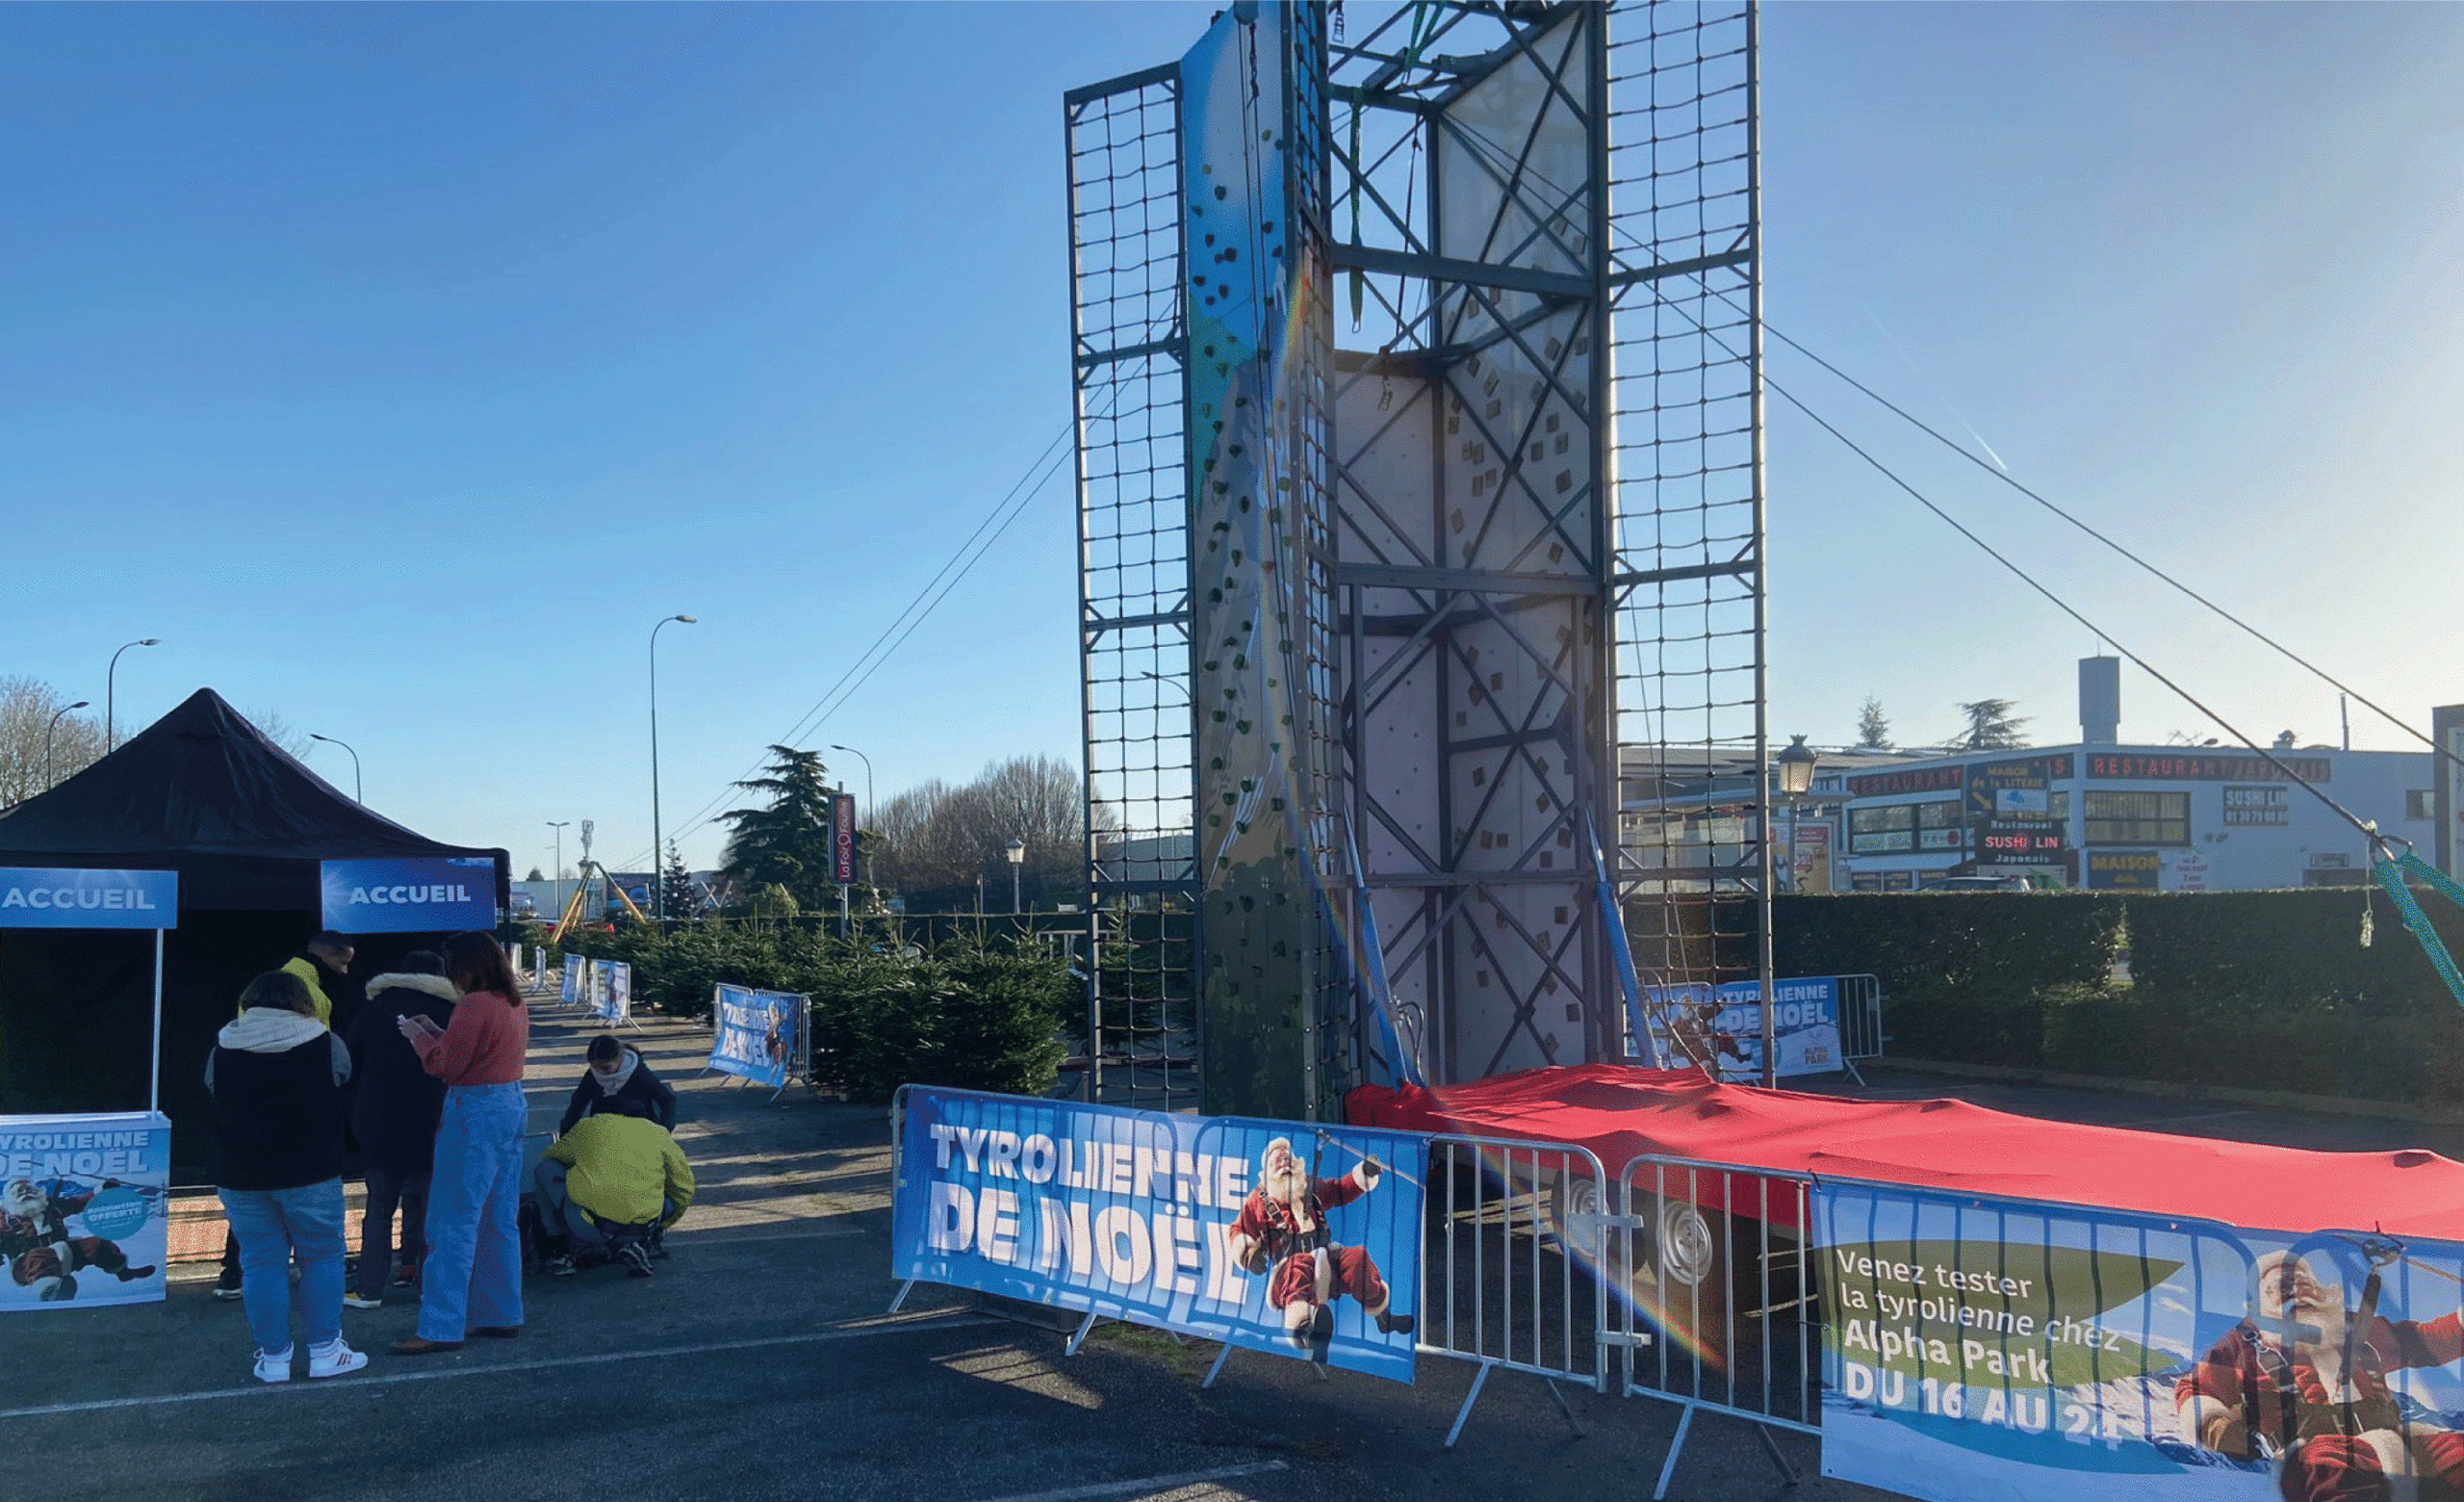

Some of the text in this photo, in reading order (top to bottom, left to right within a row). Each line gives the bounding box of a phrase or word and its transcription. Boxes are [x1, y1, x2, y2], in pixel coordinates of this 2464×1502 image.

[2094, 758, 2229, 775] RESTAURANT
[2226, 790, 2287, 806] SUSHI LIN
[1990, 820, 2052, 829] Restaurant
[1985, 836, 2058, 848] SUSHI LIN
[1995, 853, 2050, 864] Japonais
[2091, 856, 2159, 870] MAISON
[2, 888, 156, 910] ACCUEIL
[347, 884, 472, 905] ACCUEIL
[44, 1148, 149, 1176] NOËL
[930, 1124, 1249, 1211] TYROLIENNE
[89, 1207, 142, 1223] OFFERTE
[928, 1180, 1250, 1305] DE NOËL
[1836, 1249, 2033, 1299] Venez tester
[1841, 1282, 2122, 1354] la tyrolienne chez
[1844, 1318, 2052, 1385] Alpha Park
[1845, 1362, 2123, 1451] DU 16 AU 24
